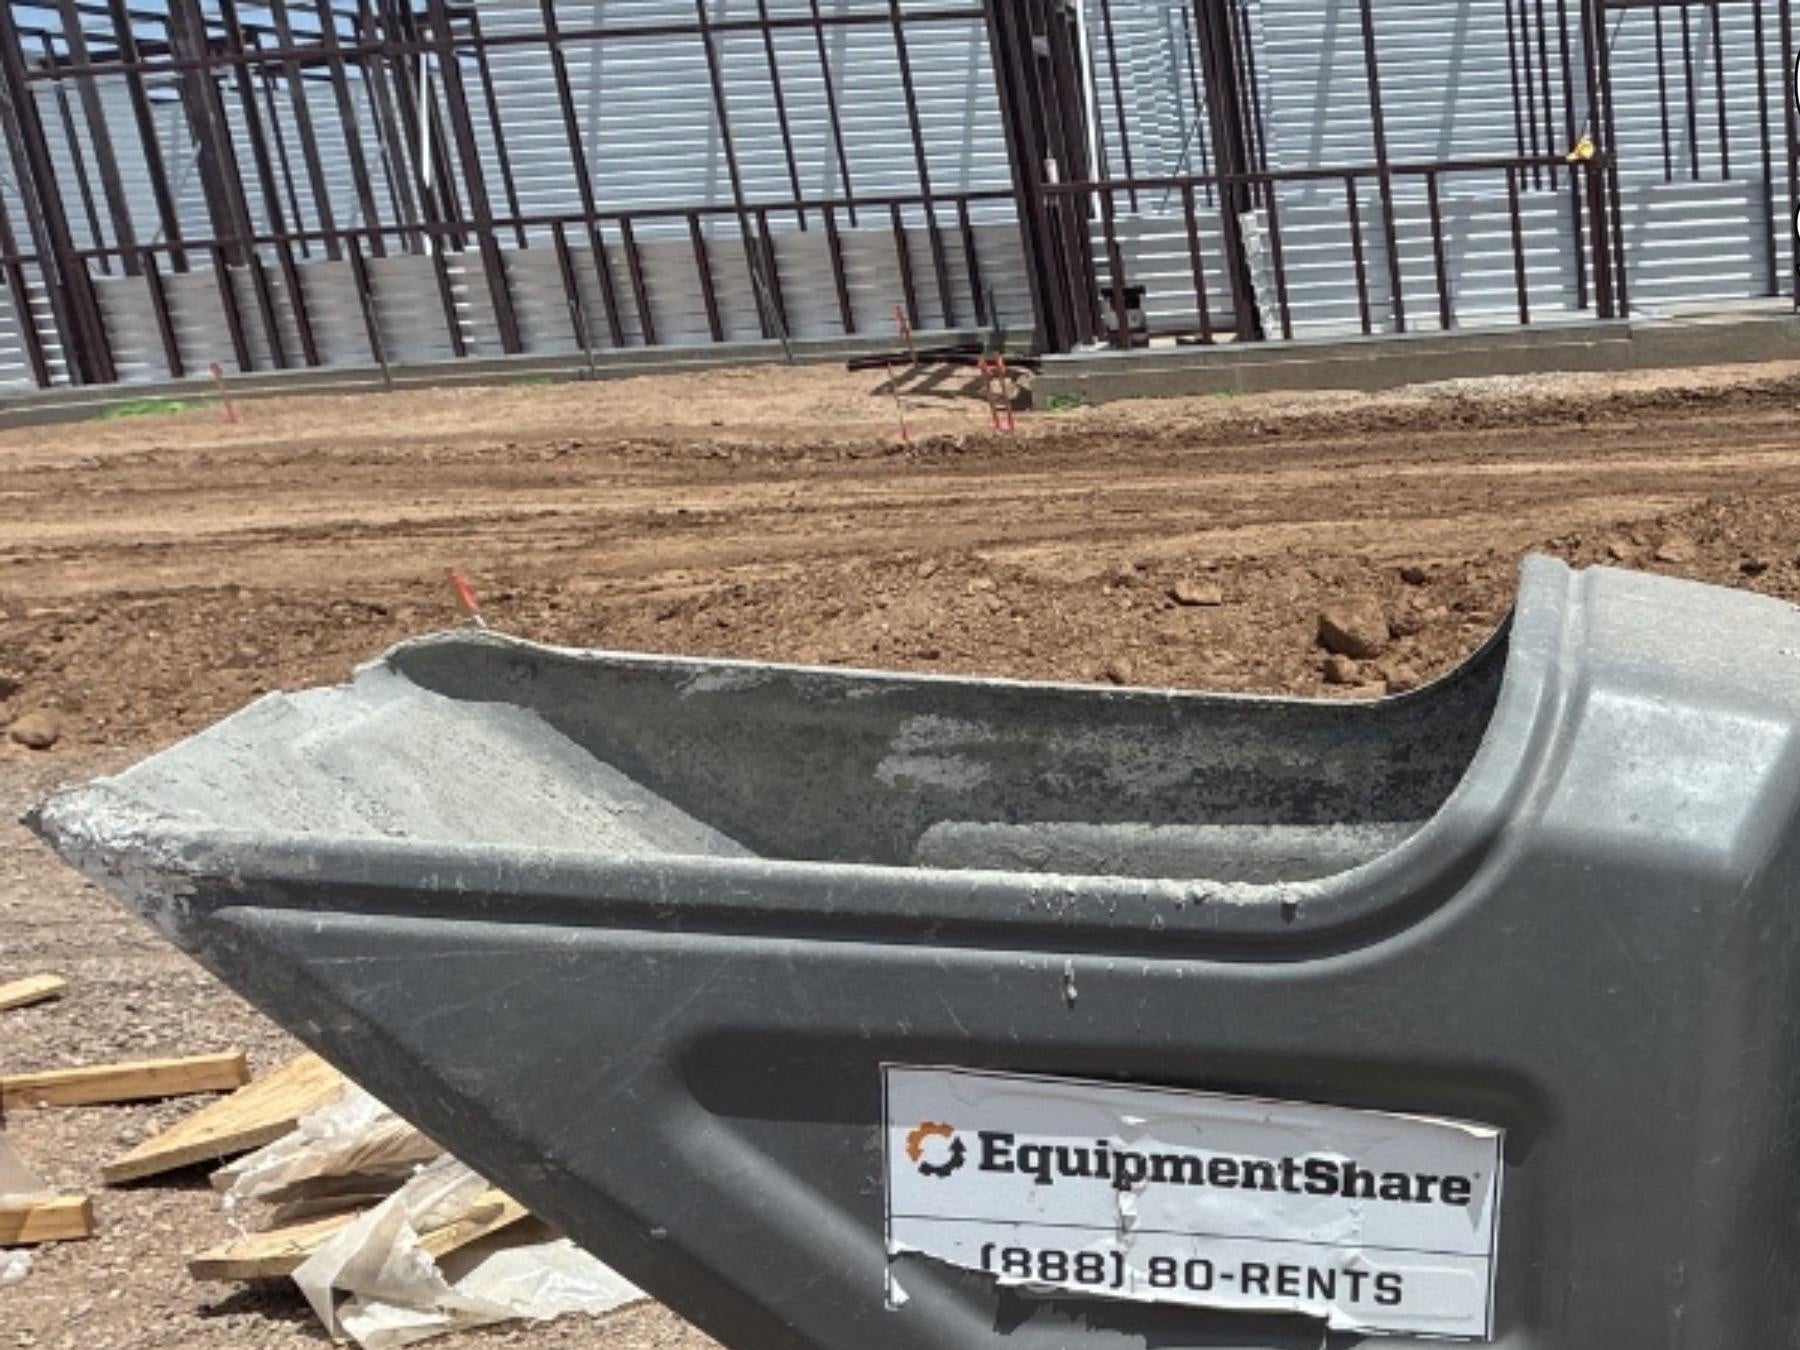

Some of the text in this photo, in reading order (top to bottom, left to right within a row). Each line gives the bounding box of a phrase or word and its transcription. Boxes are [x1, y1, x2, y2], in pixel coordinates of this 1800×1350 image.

[977, 1131, 1474, 1207] EquipmentShare
[981, 1242, 1403, 1305] (888) 80-RENTS
